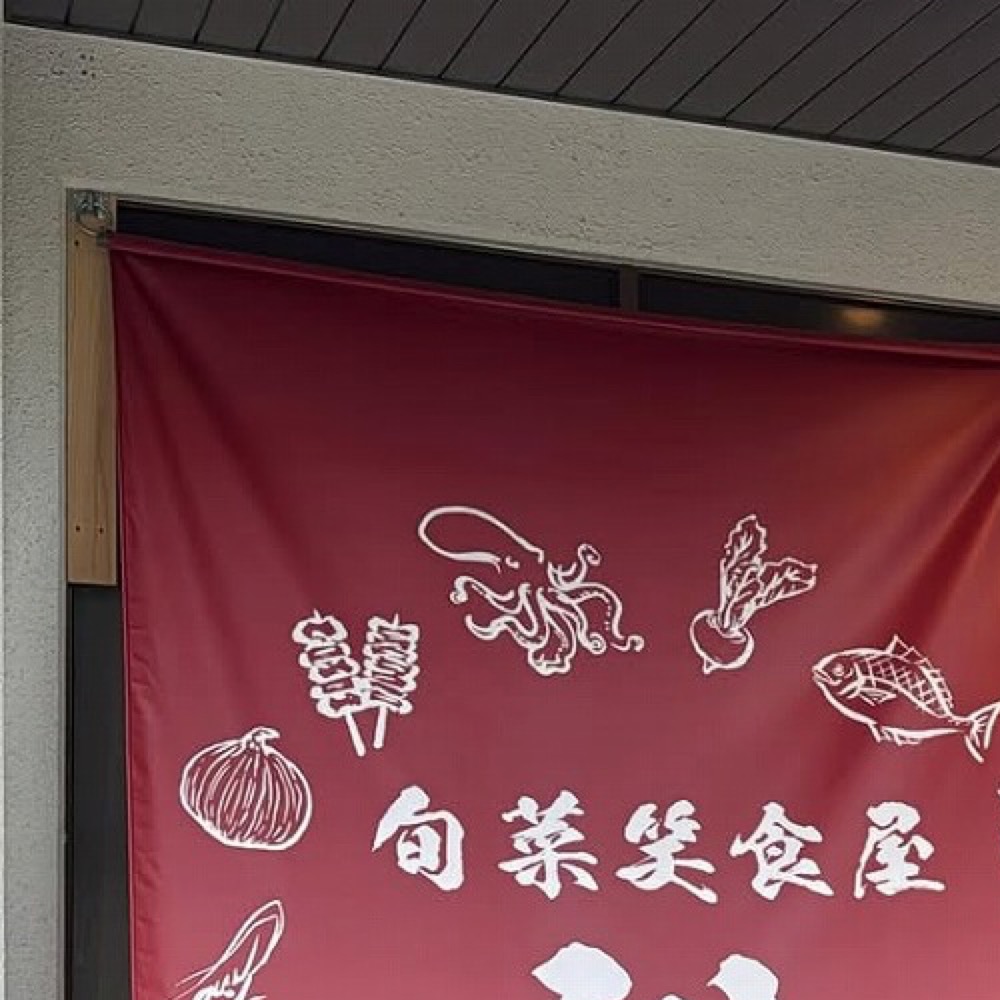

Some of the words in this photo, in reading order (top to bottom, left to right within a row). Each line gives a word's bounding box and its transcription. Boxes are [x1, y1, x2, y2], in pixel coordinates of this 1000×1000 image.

[371, 785, 946, 904] 旬菜笑食屋
